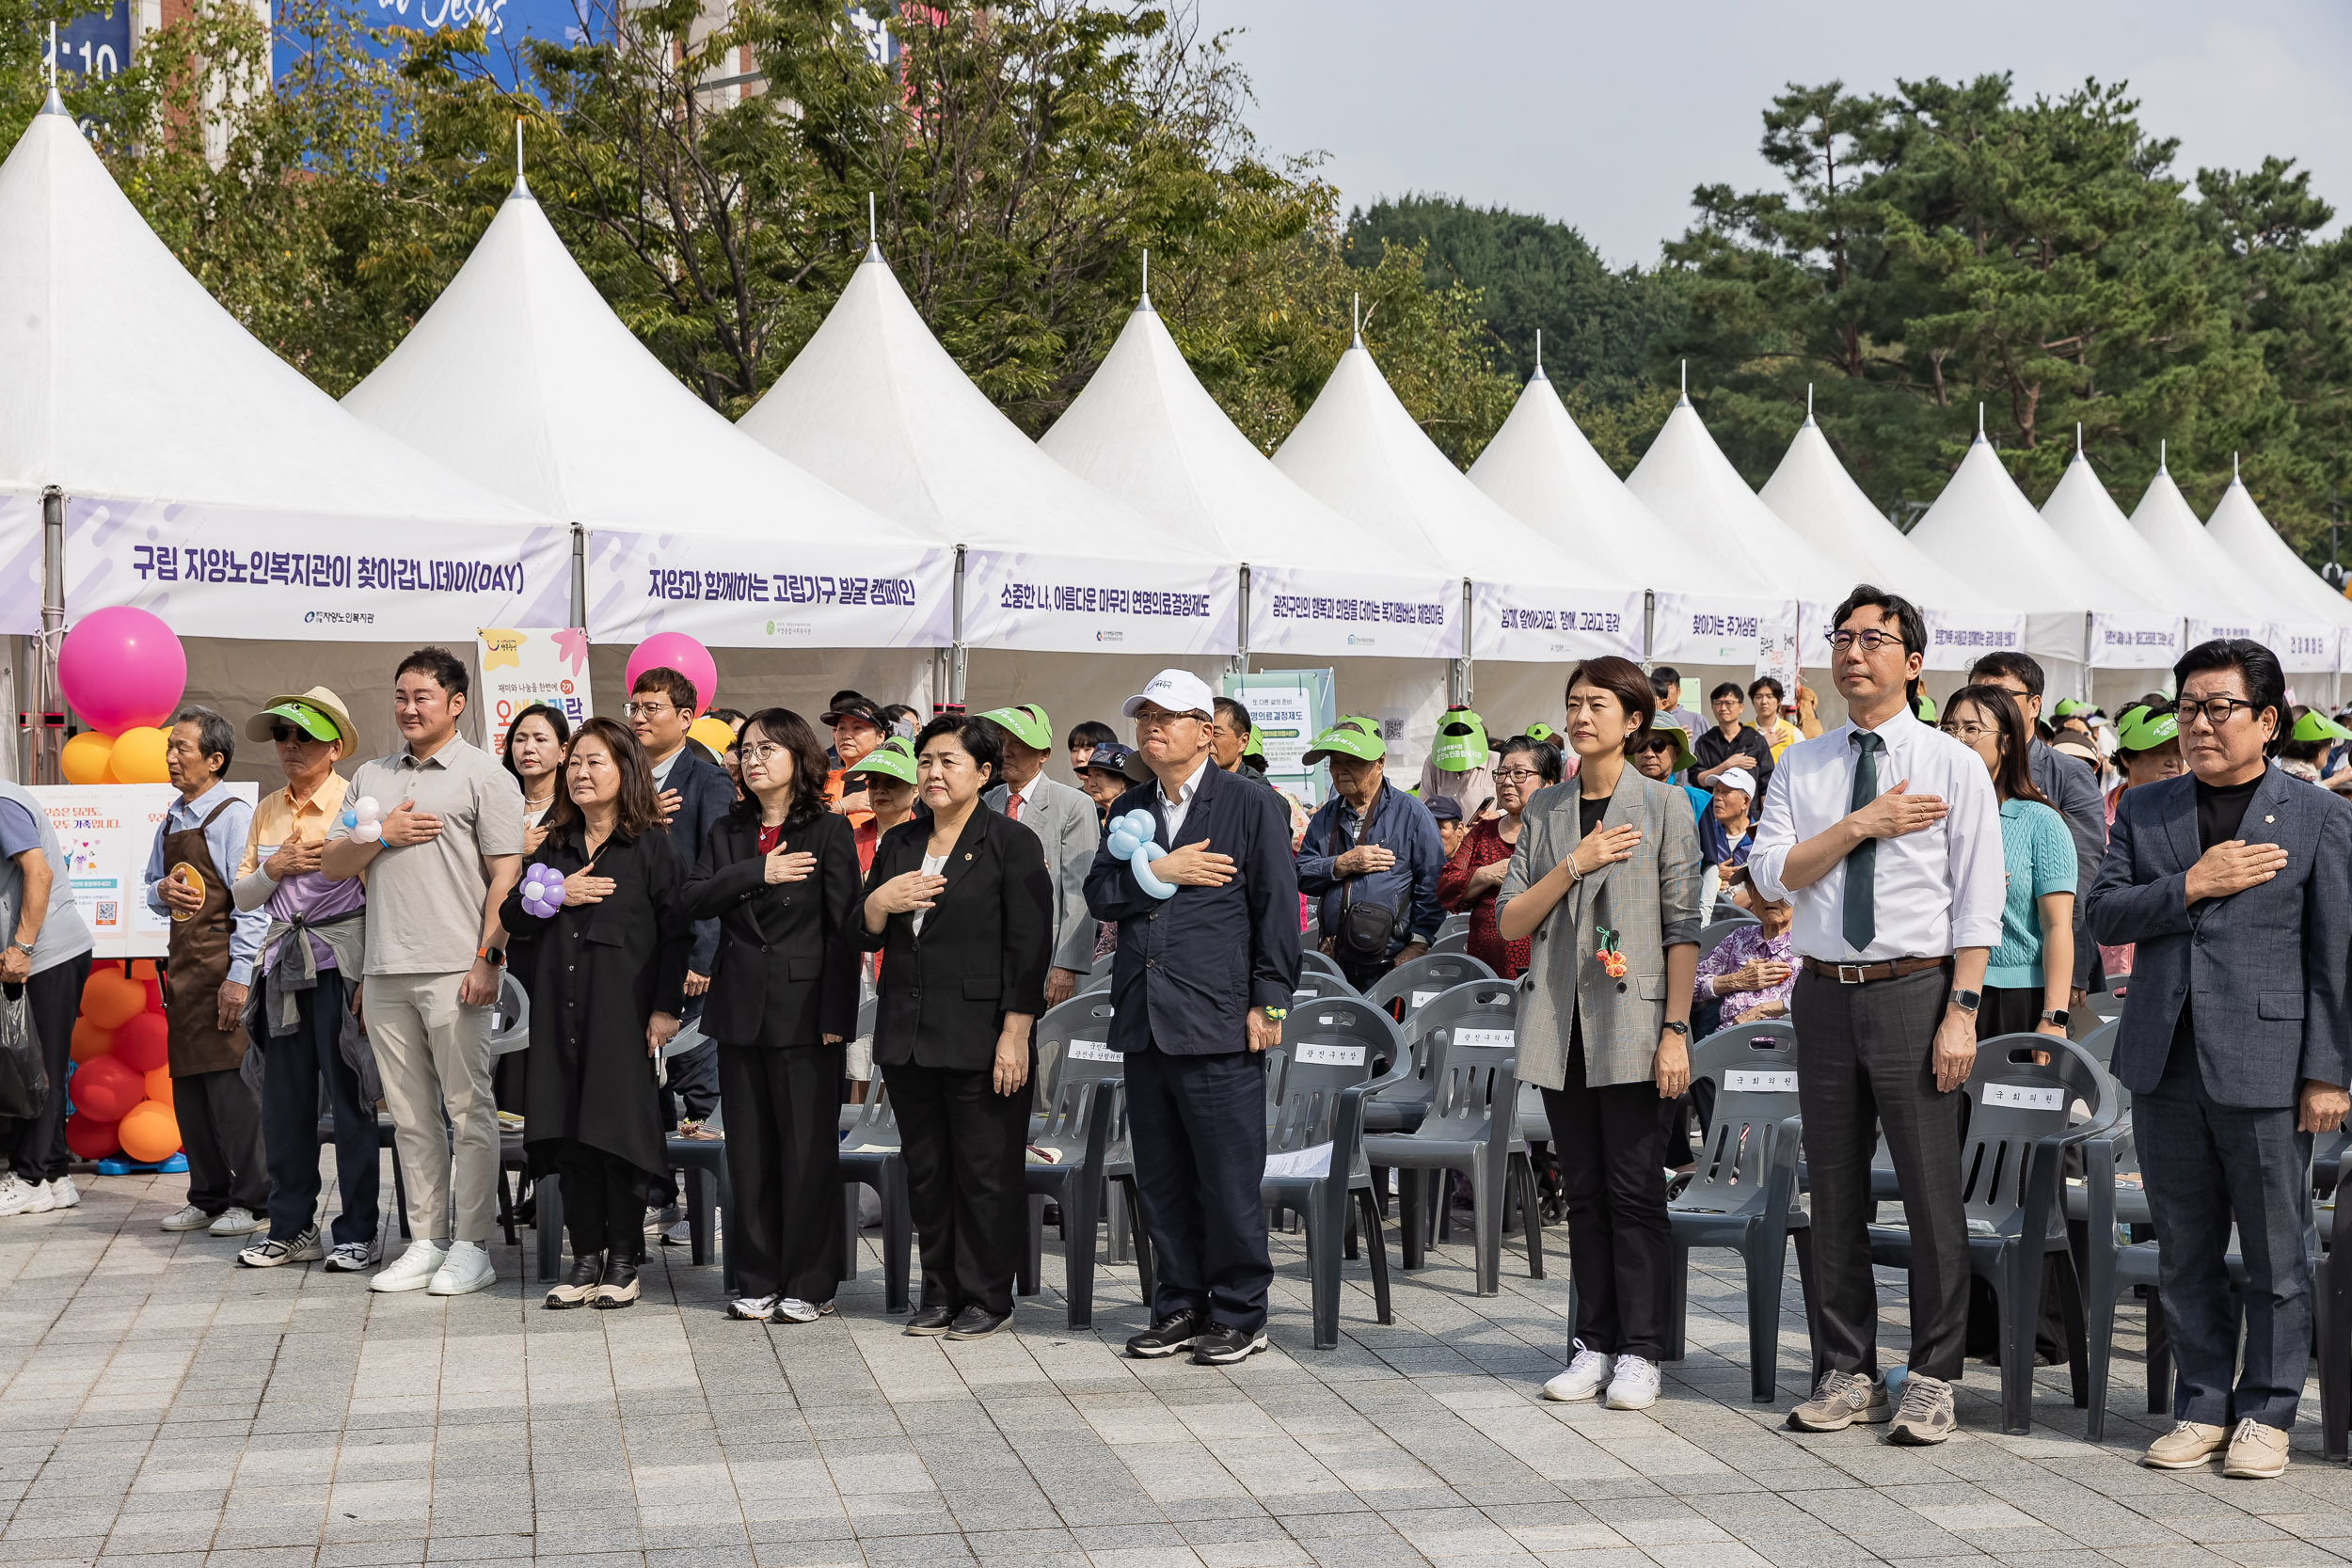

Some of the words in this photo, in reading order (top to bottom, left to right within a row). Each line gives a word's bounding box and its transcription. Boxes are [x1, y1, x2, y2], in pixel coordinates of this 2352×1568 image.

[133, 545, 179, 581] 구립
[184, 547, 352, 589] 자양노인복지관이
[358, 555, 525, 595] 찾아갑니데이(DAY)
[647, 569, 702, 600] 자양과
[705, 571, 770, 603] 함께하는
[772, 574, 836, 605] 고립가구
[839, 577, 868, 606] 발굴
[870, 578, 915, 607] 캠페인
[1000, 583, 1035, 610] 소중한
[1037, 585, 1052, 611] 나,
[1054, 586, 1096, 612] 아름다운
[1099, 588, 1130, 614] 마무리
[1132, 590, 1211, 617] 연명의료결정제도
[1273, 594, 1311, 619] 광진구민의
[1311, 596, 1335, 620] 행복과
[1336, 598, 1358, 621] 희망을
[1359, 600, 1380, 622] 더하는
[1417, 604, 1444, 626] 체험마당
[324, 611, 374, 624] 자양노인복지관
[1519, 610, 1556, 629] 알아가요!
[1580, 612, 1604, 632] 그리고
[1605, 612, 1621, 633] 공감
[1692, 613, 1724, 637] 찾아가는
[1726, 614, 1757, 638] 주거상담
[498, 683, 517, 693] 재미와
[518, 682, 538, 693] 나눔을
[539, 682, 559, 692] 한번에
[1250, 711, 1303, 721] 명의료결정제도
[73, 819, 121, 830] 가족입니다.
[1097, 1052, 1122, 1062] 당협위원
